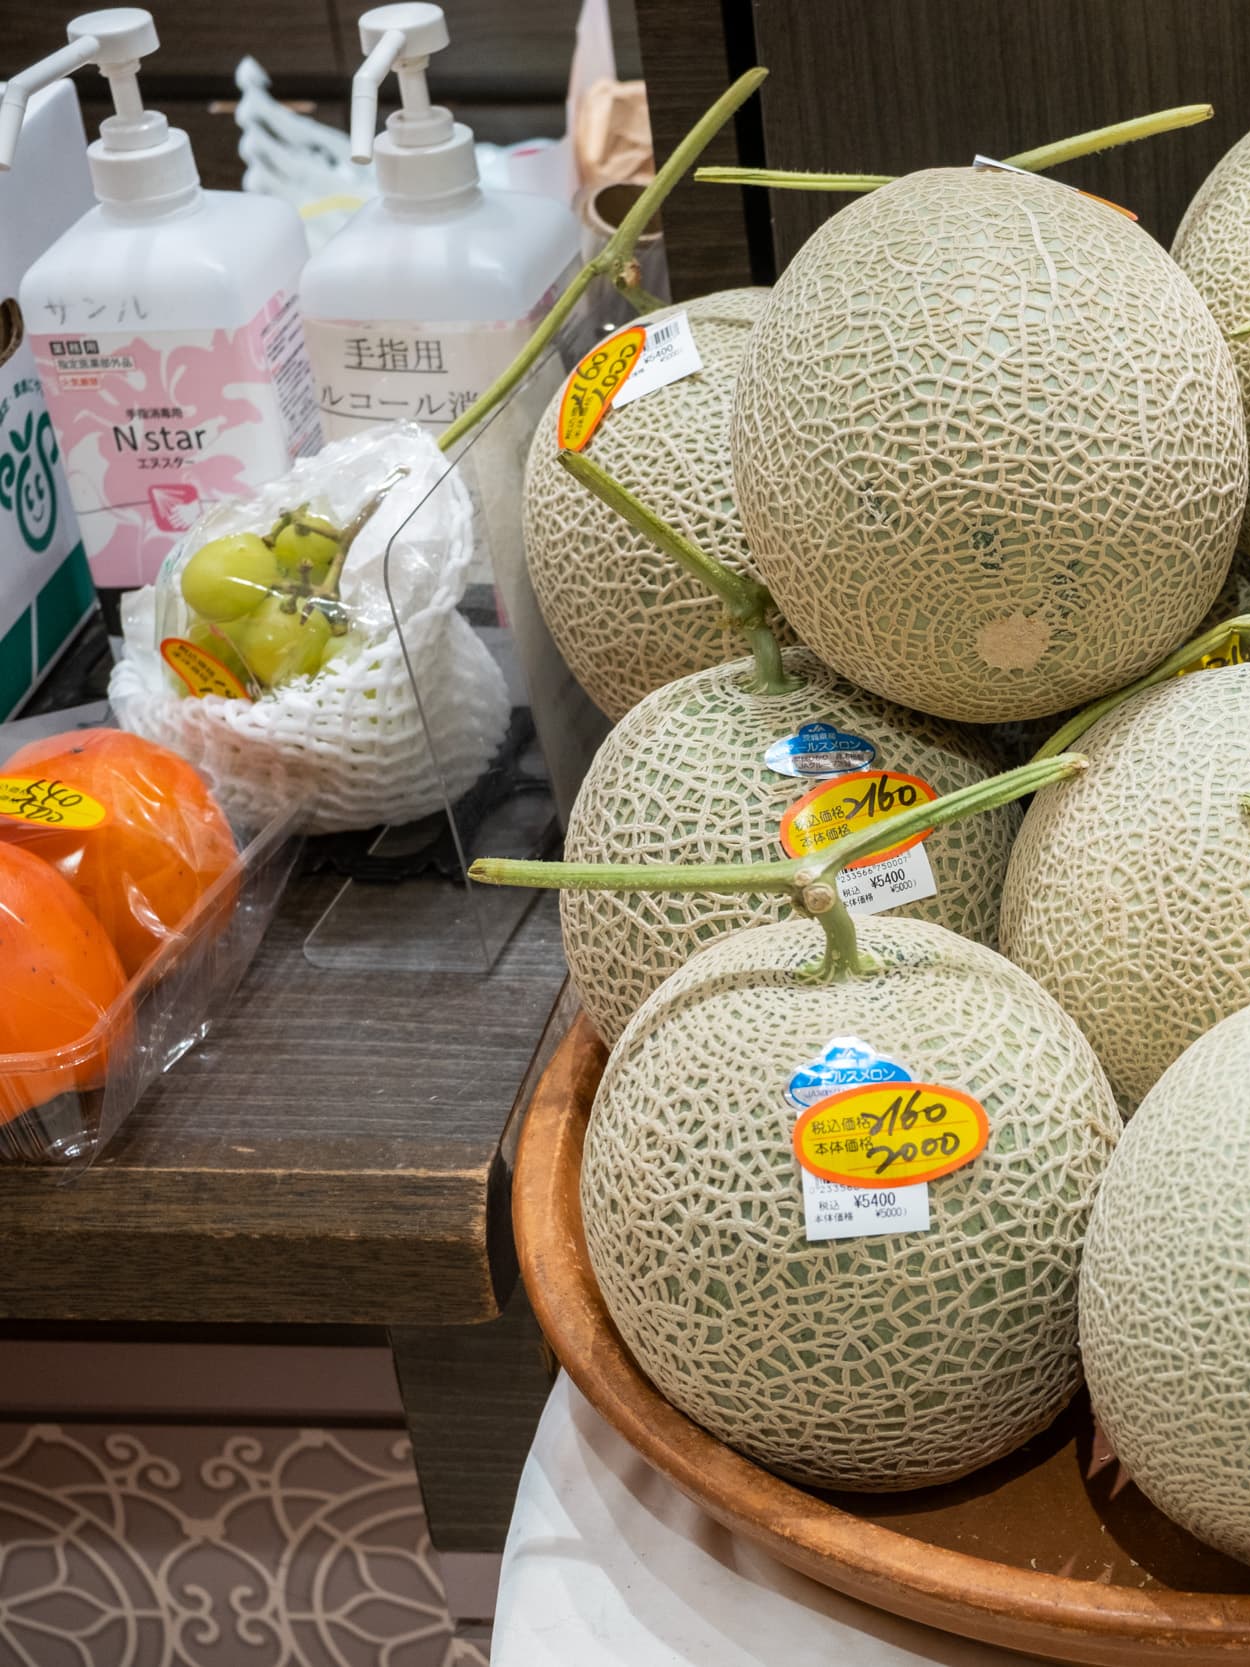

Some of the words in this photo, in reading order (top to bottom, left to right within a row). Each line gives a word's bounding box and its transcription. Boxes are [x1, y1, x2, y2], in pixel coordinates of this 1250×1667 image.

[343, 337, 445, 370] 手指用
[136, 457, 196, 470] エヌスター
[843, 774, 917, 821] 2160
[869, 868, 906, 889] ¥5400
[807, 1068, 896, 1085] アルスメロン
[811, 1117, 872, 1136] 税込価格
[860, 1089, 948, 1137] 2160
[814, 1135, 875, 1156] 本体価格
[865, 1131, 961, 1176] 2000
[818, 1200, 841, 1212] 税込
[853, 1191, 897, 1210] ¥5400
